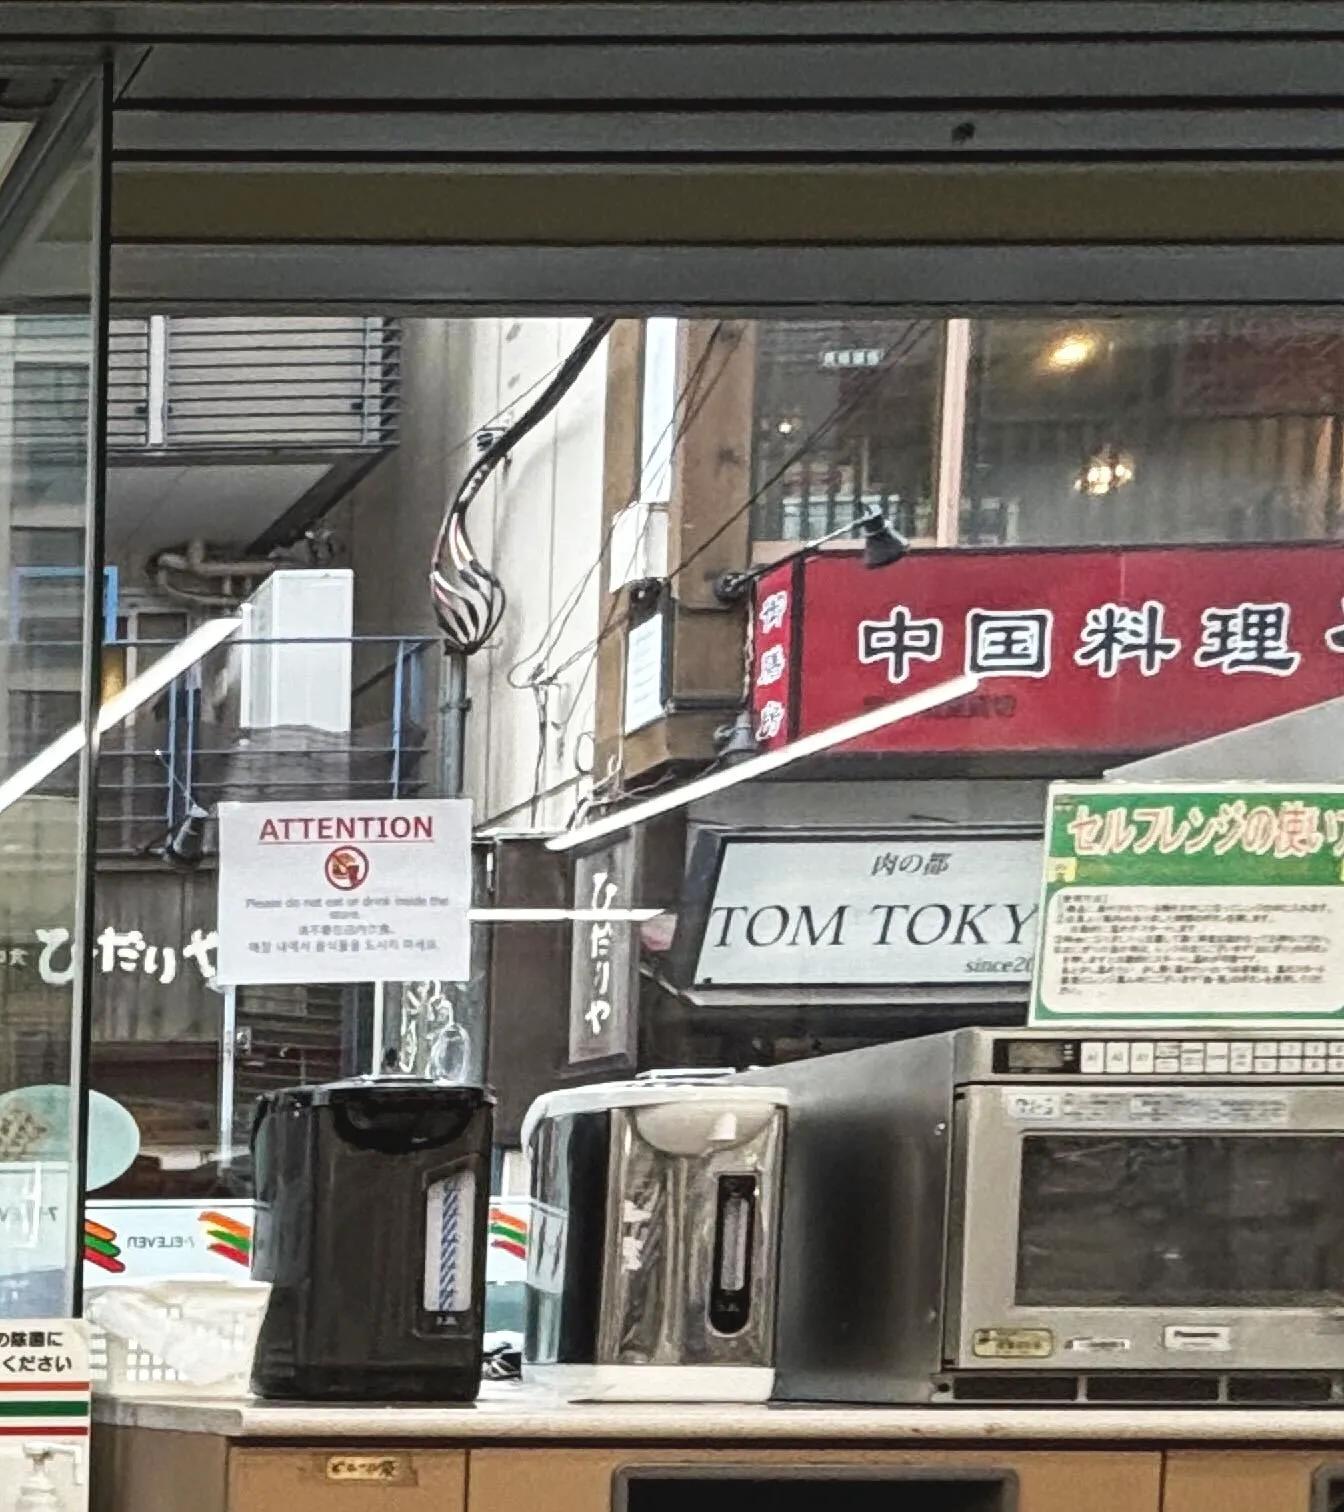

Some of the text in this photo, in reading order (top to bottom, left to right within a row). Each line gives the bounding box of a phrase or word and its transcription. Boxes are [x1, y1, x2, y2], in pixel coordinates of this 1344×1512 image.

[859, 601, 1344, 683] 中国料理
[259, 815, 434, 840] ATTENTION
[1068, 800, 1344, 860] セルフレンジの使い
[245, 898, 282, 909] Please
[285, 898, 300, 908] do
[303, 898, 322, 907] not
[362, 897, 390, 907] drink
[429, 896, 449, 906] the
[712, 903, 852, 947] TOM
